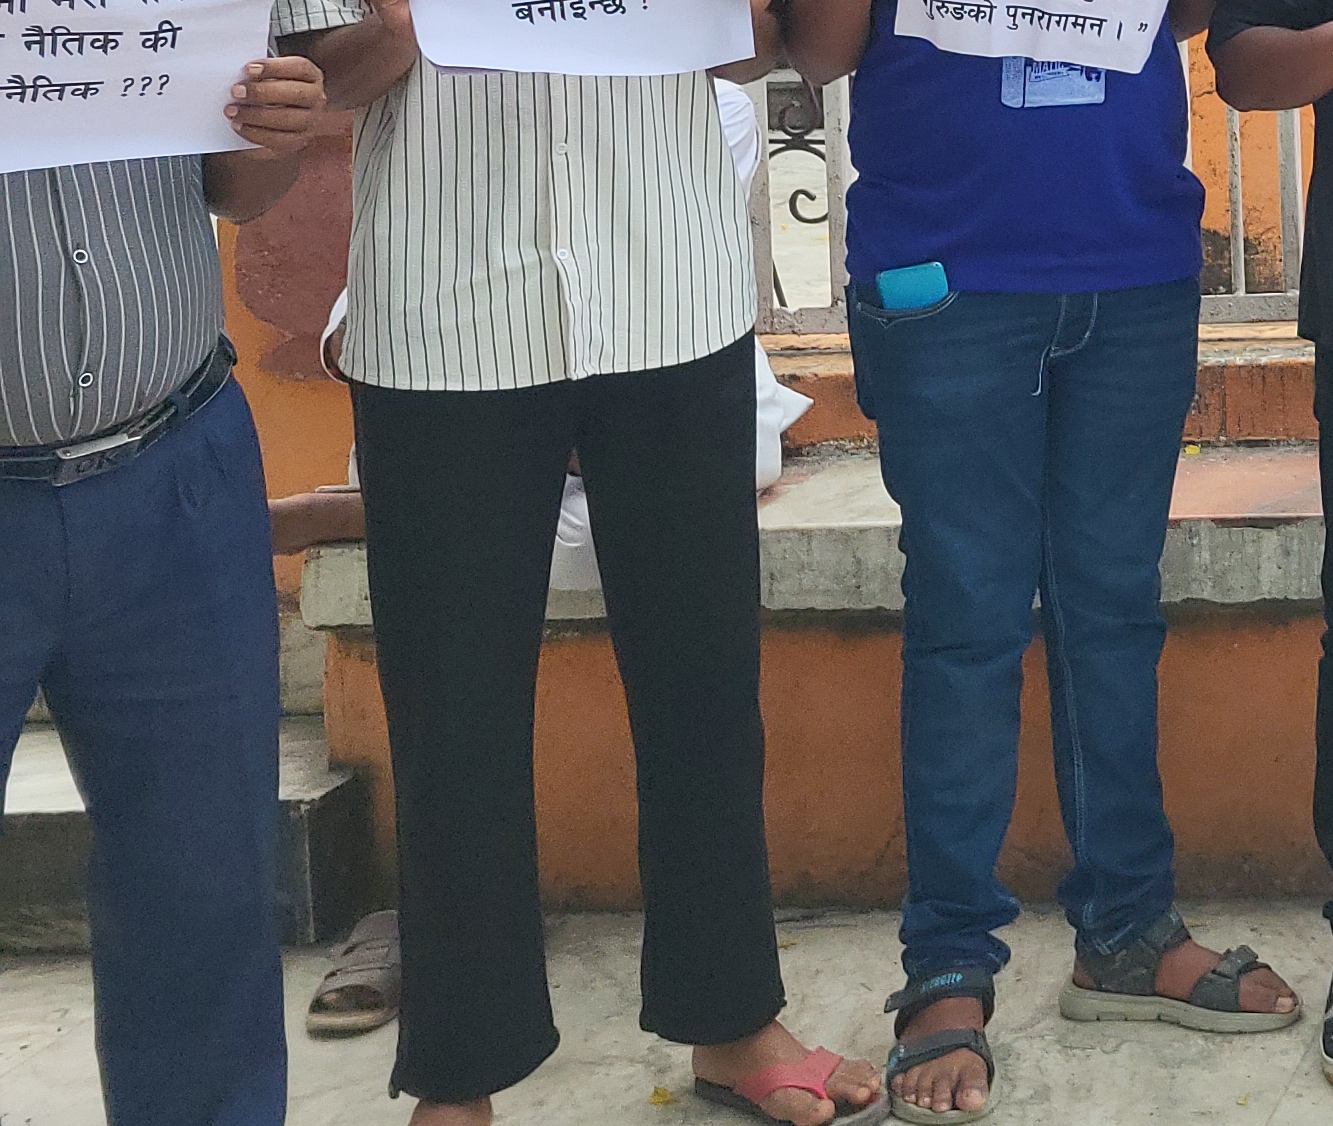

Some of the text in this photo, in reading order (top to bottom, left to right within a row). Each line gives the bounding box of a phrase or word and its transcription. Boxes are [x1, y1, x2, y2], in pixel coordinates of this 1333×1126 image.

[1005, 4, 1108, 38] पुनरागमन
[22, 20, 183, 59] नैतिक की
[0, 73, 171, 104] नैतिक ???
